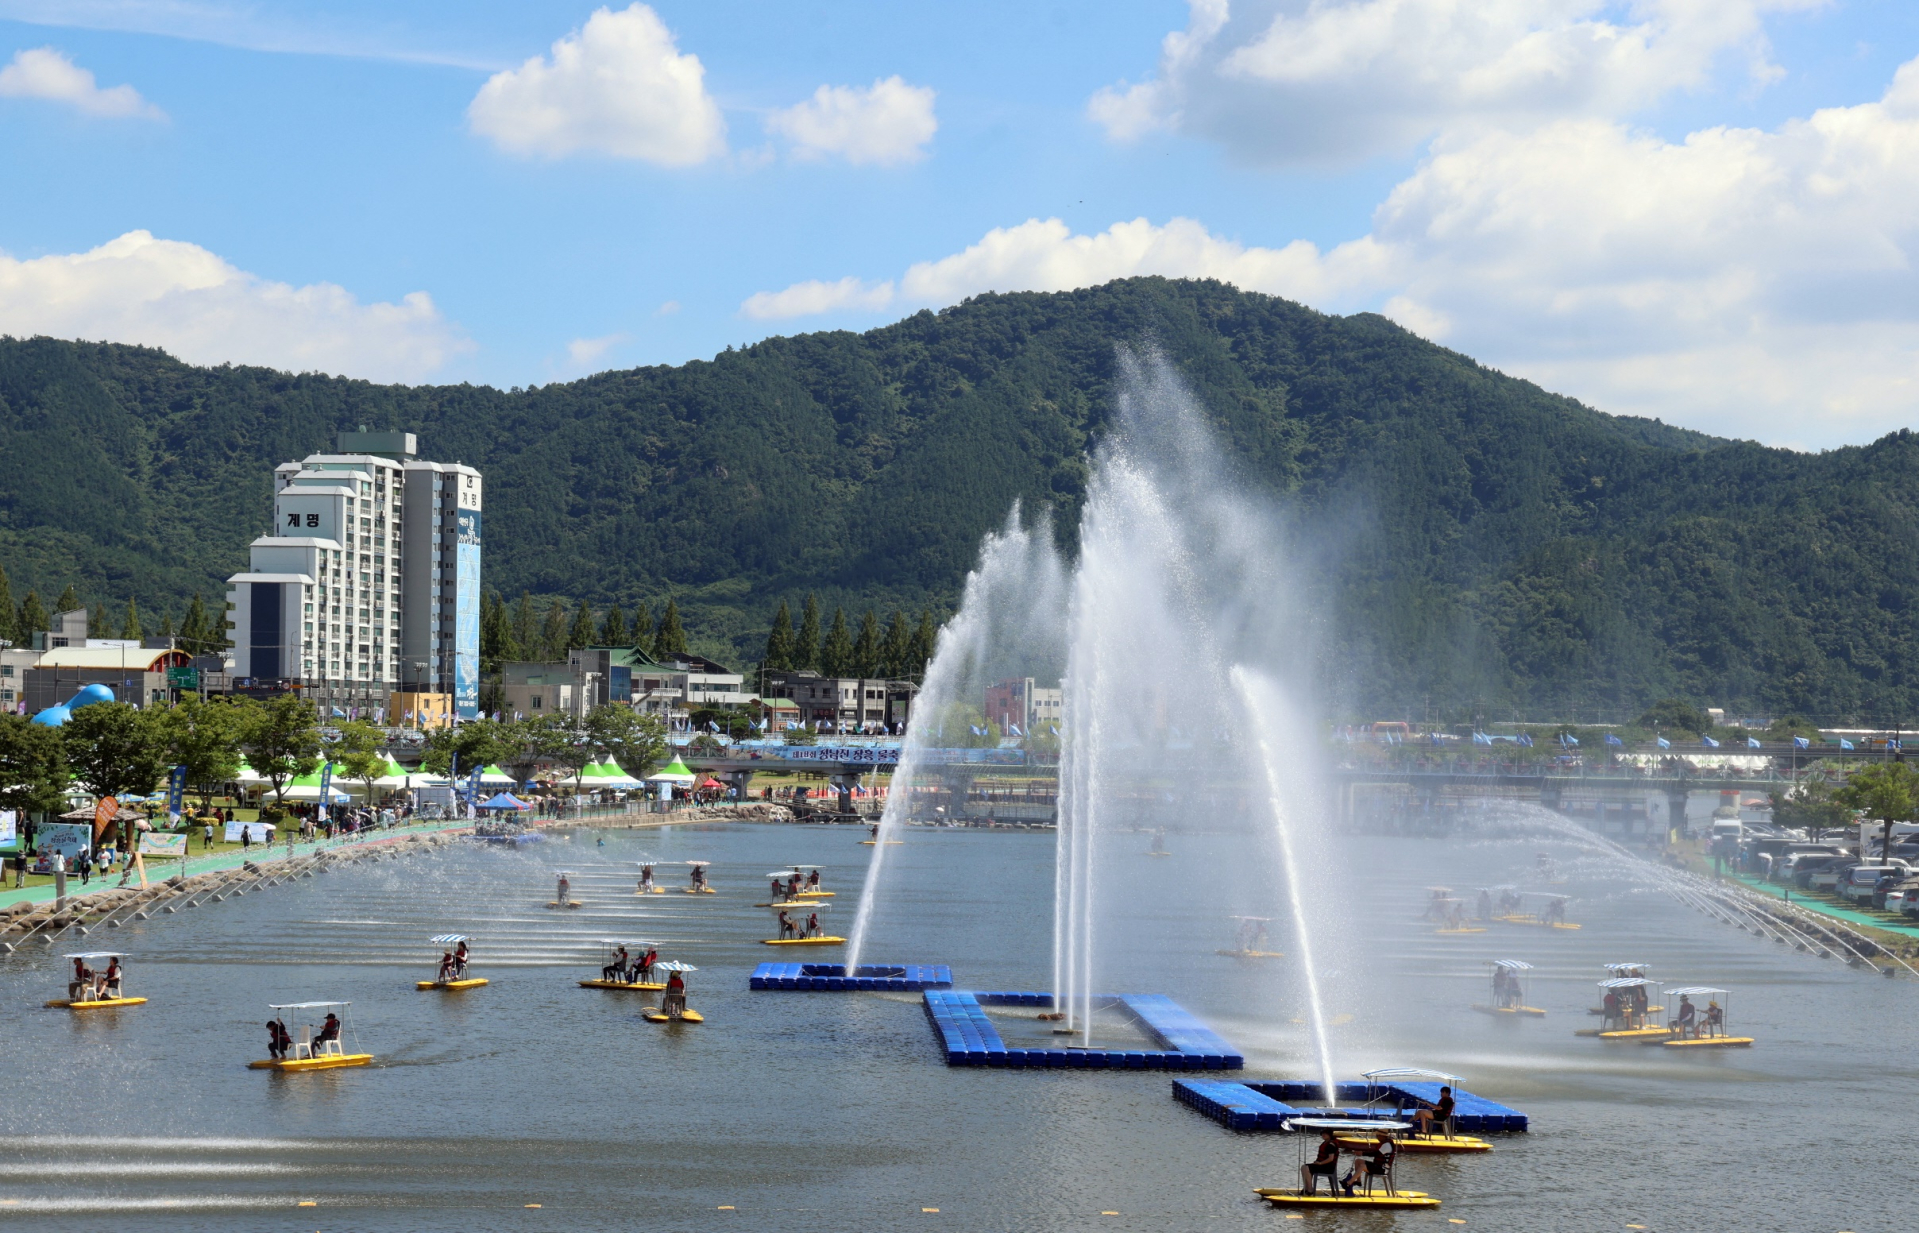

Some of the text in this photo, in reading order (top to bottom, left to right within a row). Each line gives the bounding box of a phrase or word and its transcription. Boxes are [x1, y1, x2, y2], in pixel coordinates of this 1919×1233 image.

[462, 492, 477, 506] 계명
[287, 513, 319, 528] 계명
[792, 748, 899, 762] 제18회 정남진 장흥 물축
